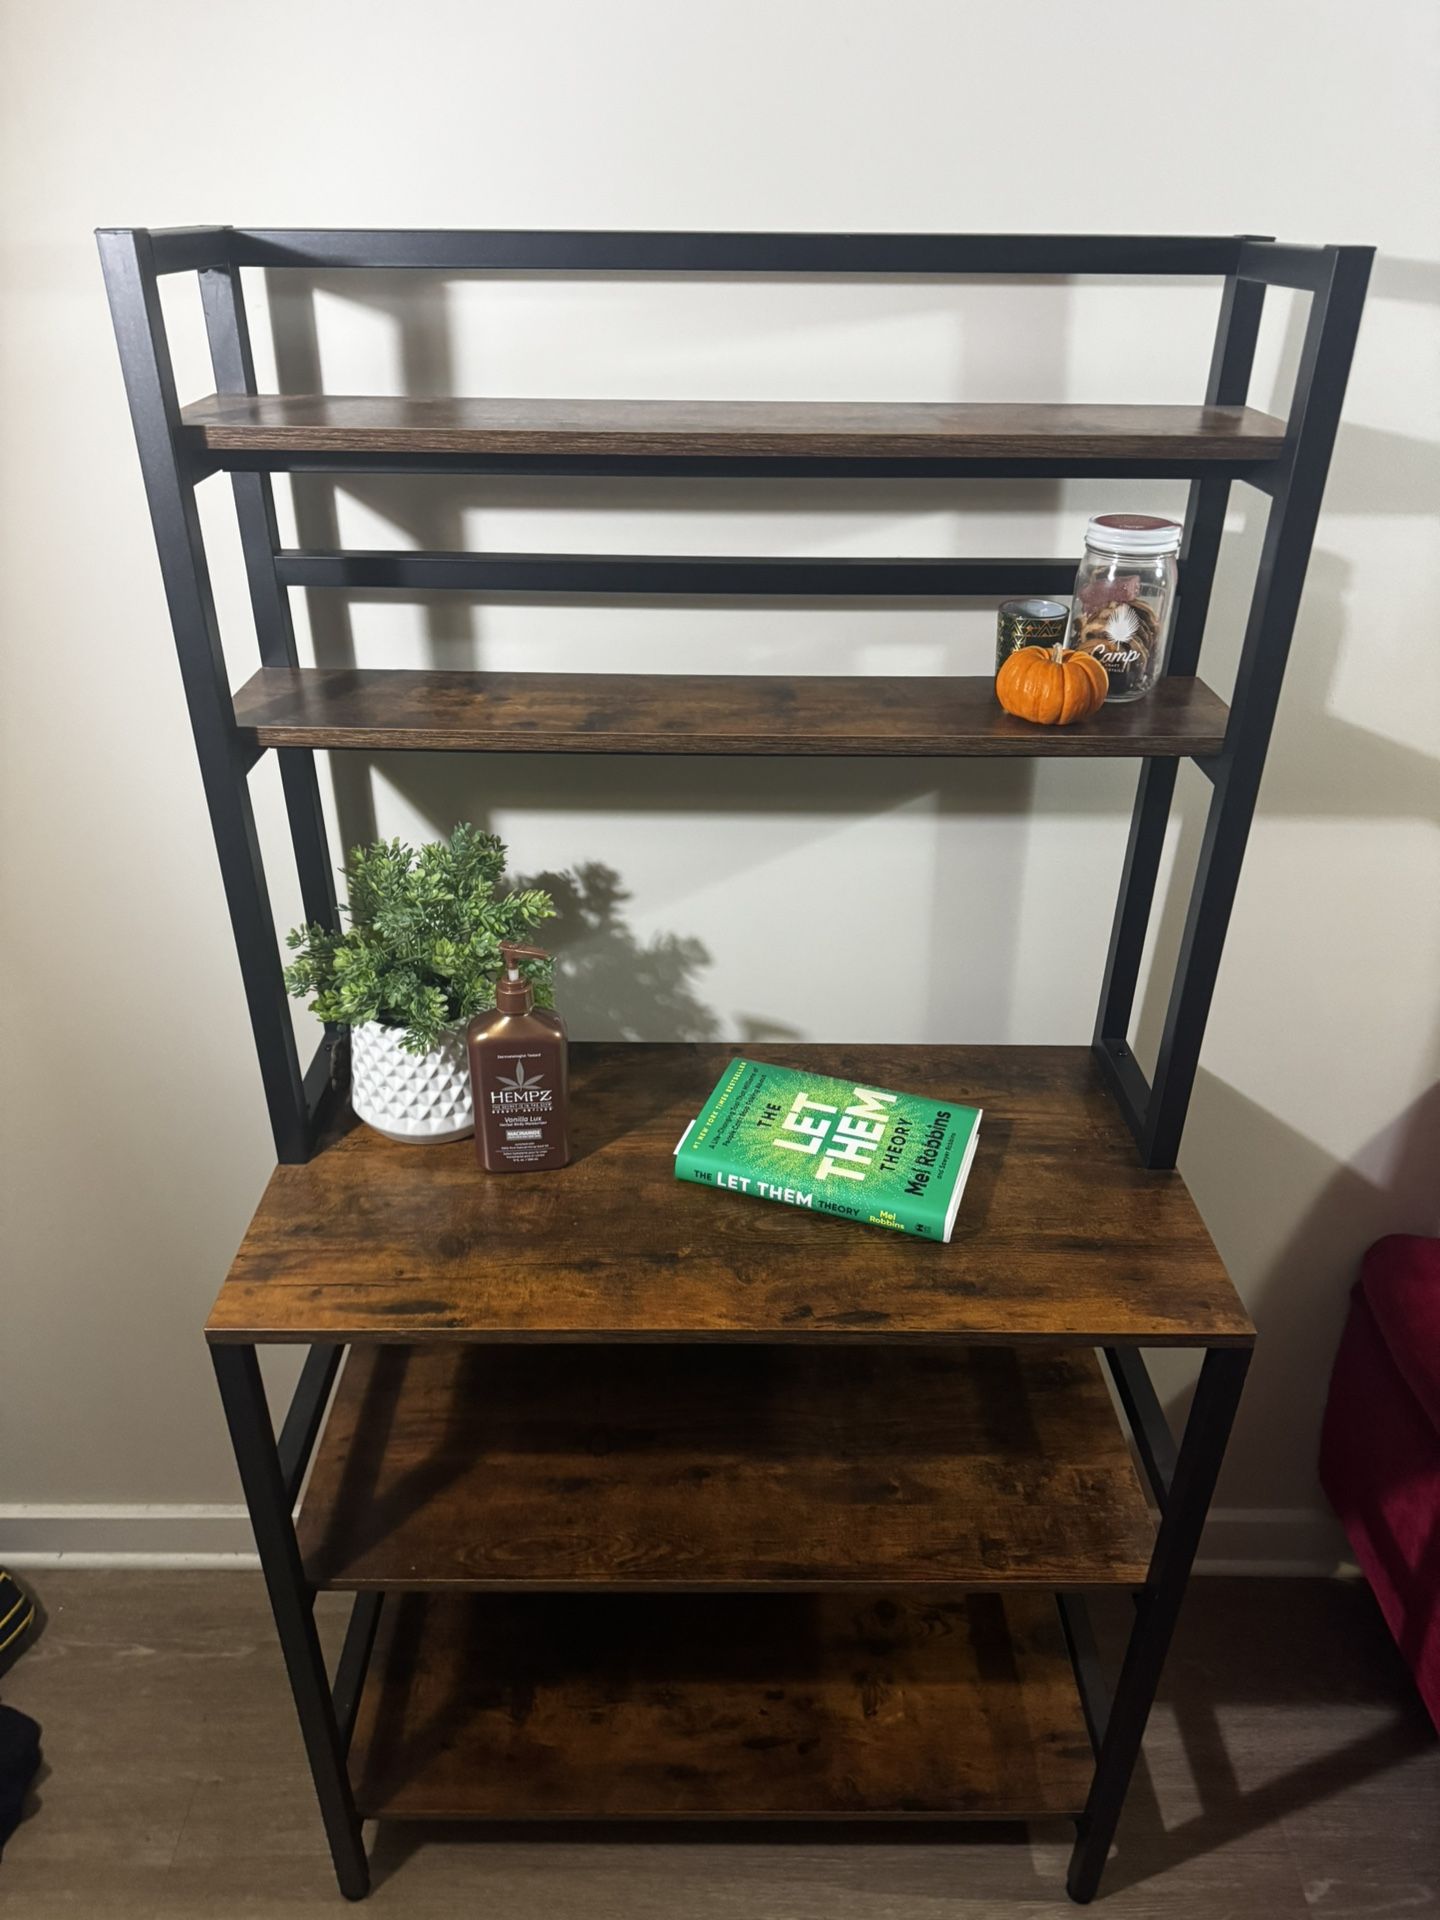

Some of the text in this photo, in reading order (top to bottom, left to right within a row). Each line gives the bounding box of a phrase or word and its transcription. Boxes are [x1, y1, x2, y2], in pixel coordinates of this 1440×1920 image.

[1091, 644, 1140, 672] Camp
[491, 1090, 552, 1104] HEMPZ
[698, 1127, 709, 1140] NEW
[707, 1111, 718, 1126] YORK
[715, 1094, 729, 1109] TIMES
[726, 1062, 747, 1092] BESTSELLER
[756, 1102, 782, 1128] THE
[772, 1091, 839, 1155] LET
[815, 1087, 897, 1181] THEM
[880, 1118, 912, 1171] THEORY
[904, 1168, 931, 1196] Mel
[918, 1110, 951, 1168] Robbins
[694, 1169, 860, 1216] THE LET THEM THEORY
[879, 1210, 896, 1220] Mel
[869, 1215, 905, 1230] Robbins
